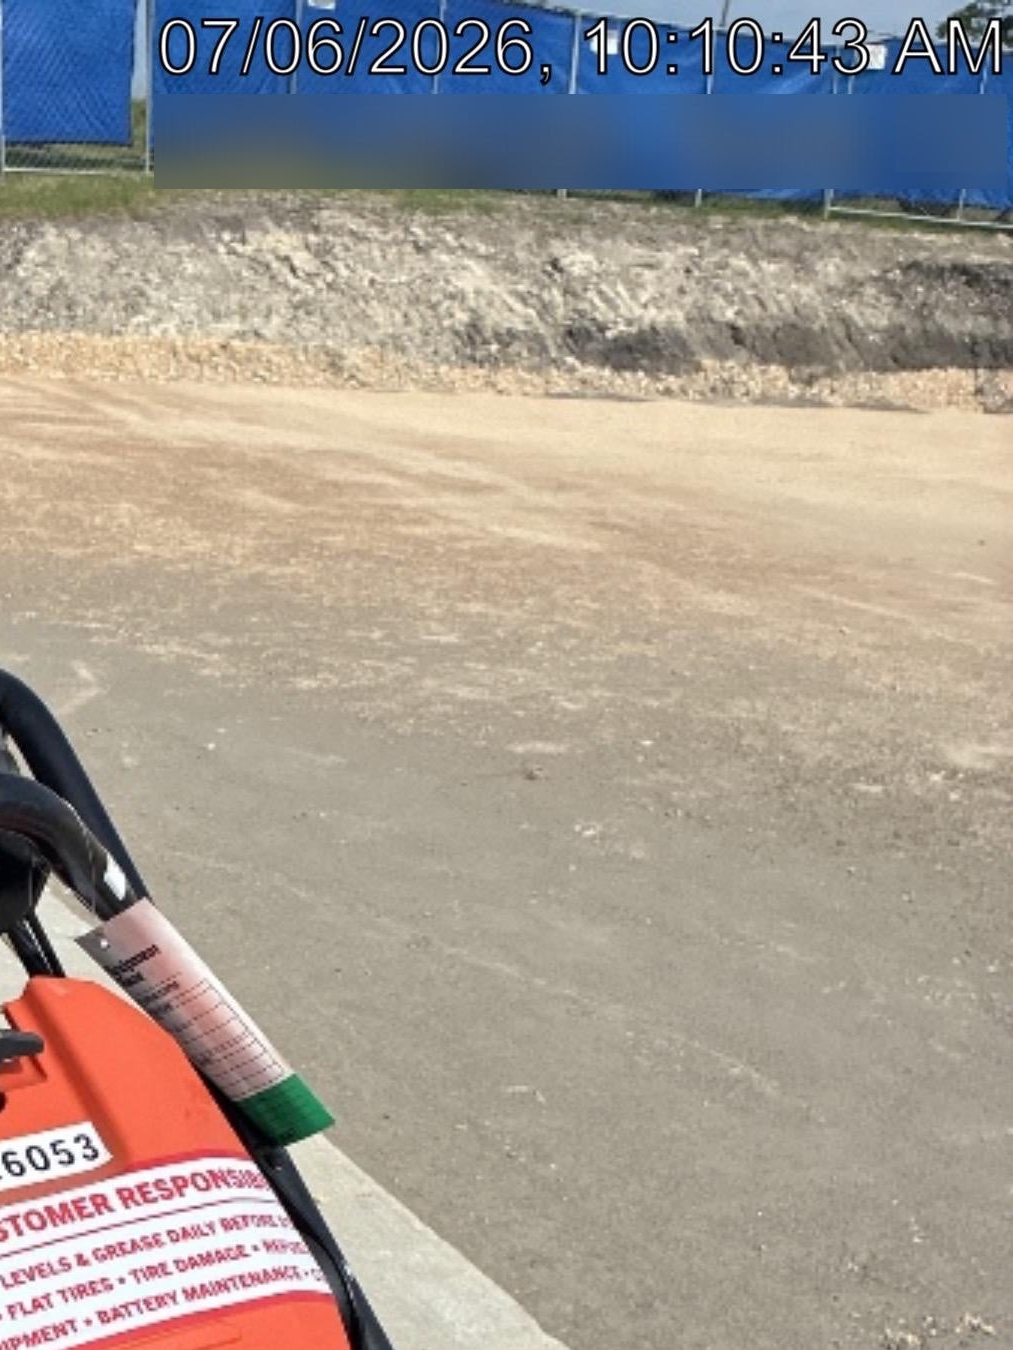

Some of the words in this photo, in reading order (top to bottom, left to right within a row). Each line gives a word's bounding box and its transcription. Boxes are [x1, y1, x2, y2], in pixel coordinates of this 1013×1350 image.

[0, 1256, 72, 1290] LEVELS
[75, 1252, 91, 1267] &
[92, 1232, 166, 1263] GREASE
[166, 1220, 217, 1244] DAILY
[6, 1292, 54, 1321] FLAT
[56, 1276, 114, 1304] TIRES
[128, 1261, 173, 1285] TIRE
[173, 1244, 250, 1273] DAMAGE
[95, 1290, 179, 1326] BATTERY
[181, 1265, 302, 1301] MAINTENANCE
